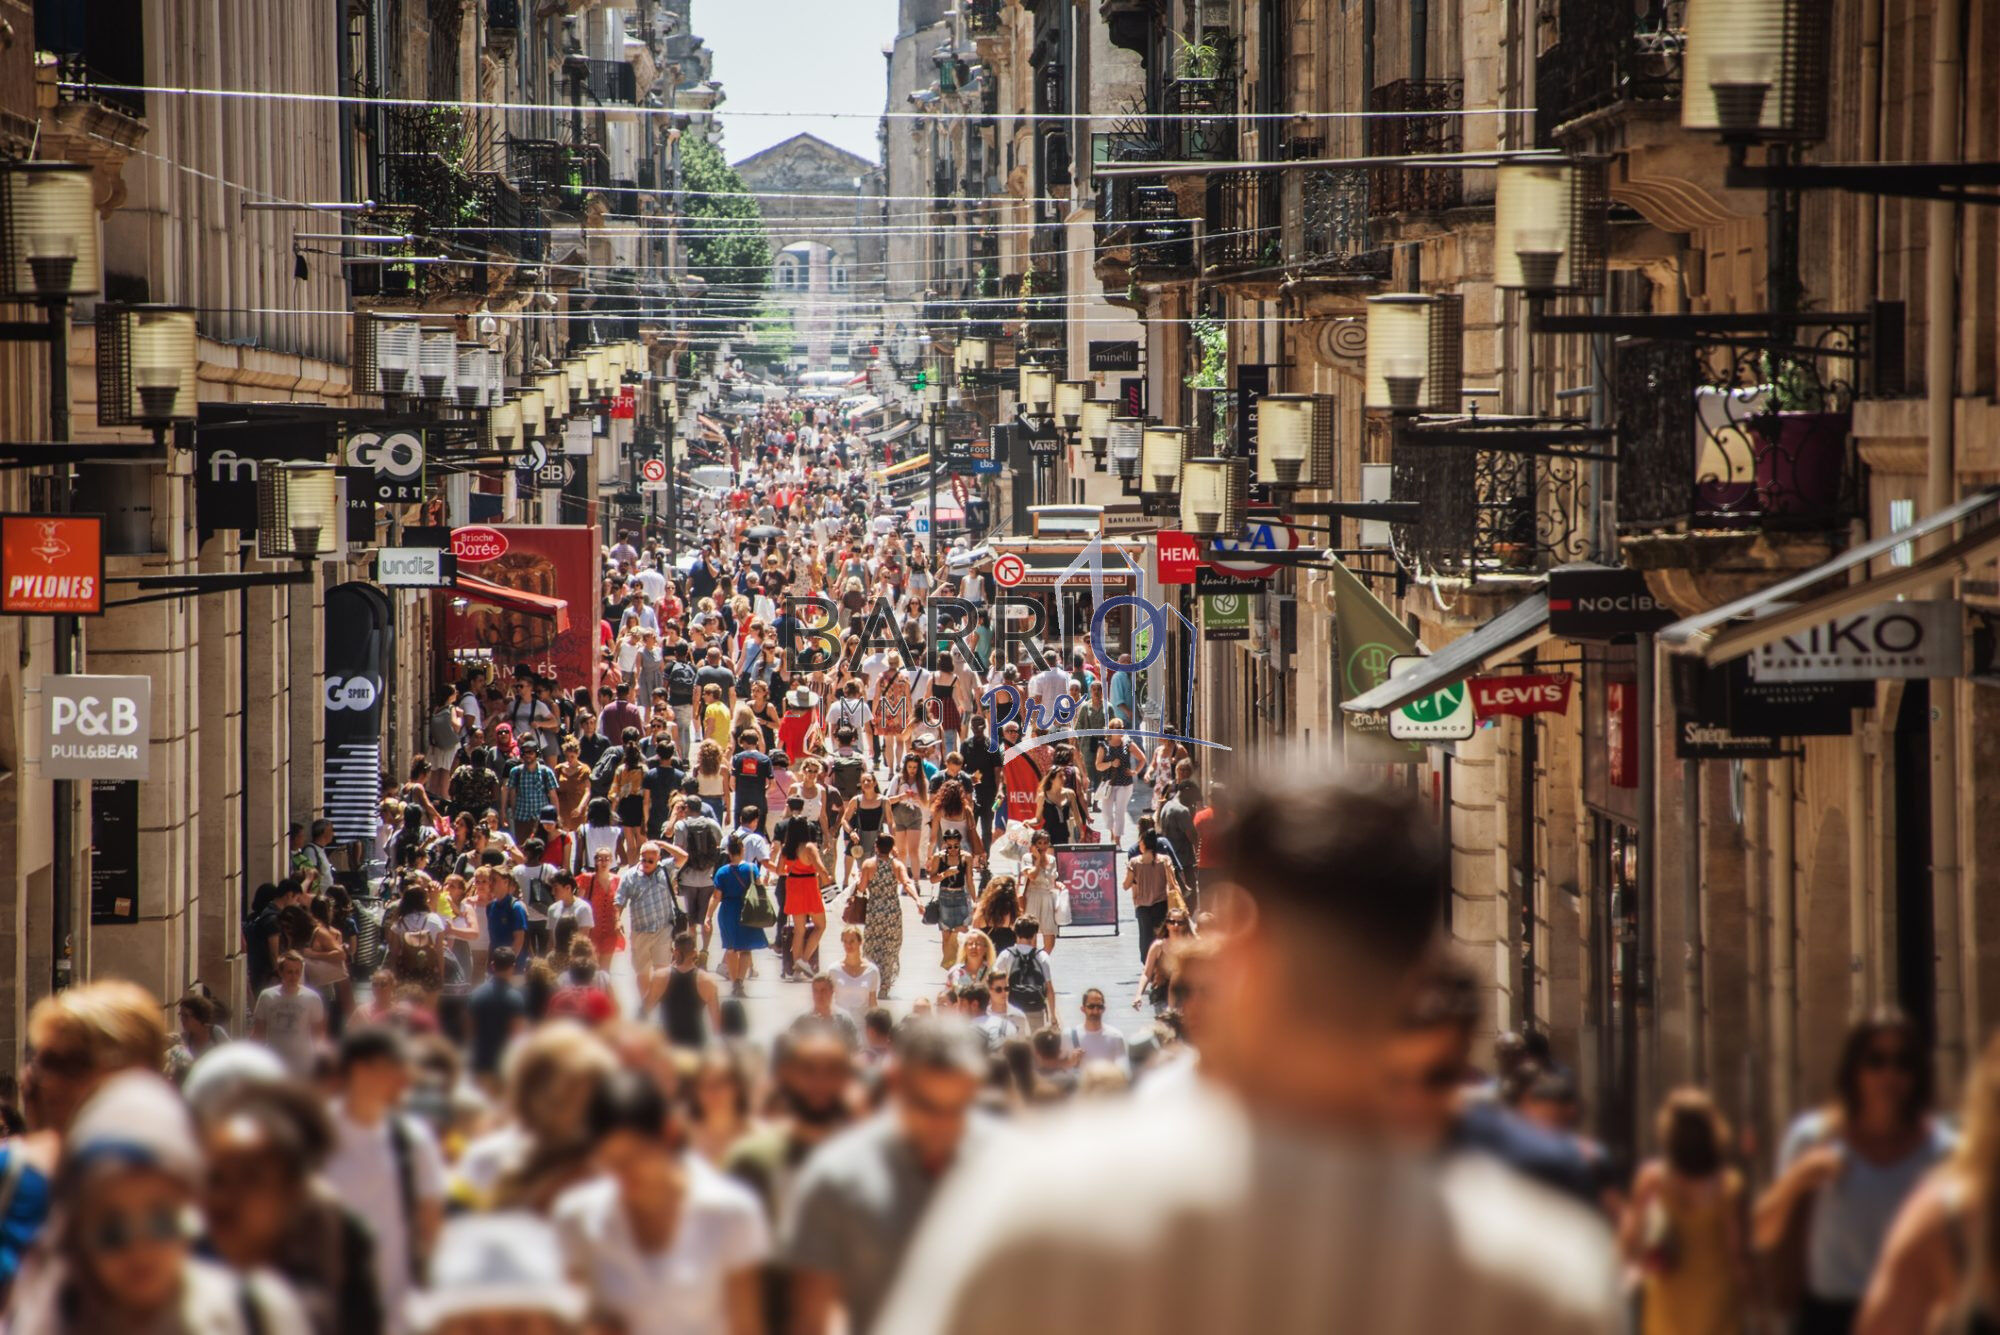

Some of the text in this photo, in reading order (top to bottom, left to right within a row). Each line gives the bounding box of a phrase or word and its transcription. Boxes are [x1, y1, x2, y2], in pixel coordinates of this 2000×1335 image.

[1096, 351, 1132, 362] minelli
[1249, 389, 1259, 456] FAIRLY
[1029, 440, 1058, 451] VANS
[346, 432, 423, 476] GO
[461, 533, 494, 542] Brioche
[453, 541, 500, 556] Dorée
[382, 556, 435, 575] undiz
[9, 576, 95, 599] PYLONES
[1022, 576, 1047, 585] ARKET
[347, 688, 370, 698] SPORT
[51, 696, 138, 736] P&B
[51, 744, 138, 759] PULL&BEAR
[1063, 868, 1110, 890] -50%
[1080, 890, 1103, 899] TOUT
